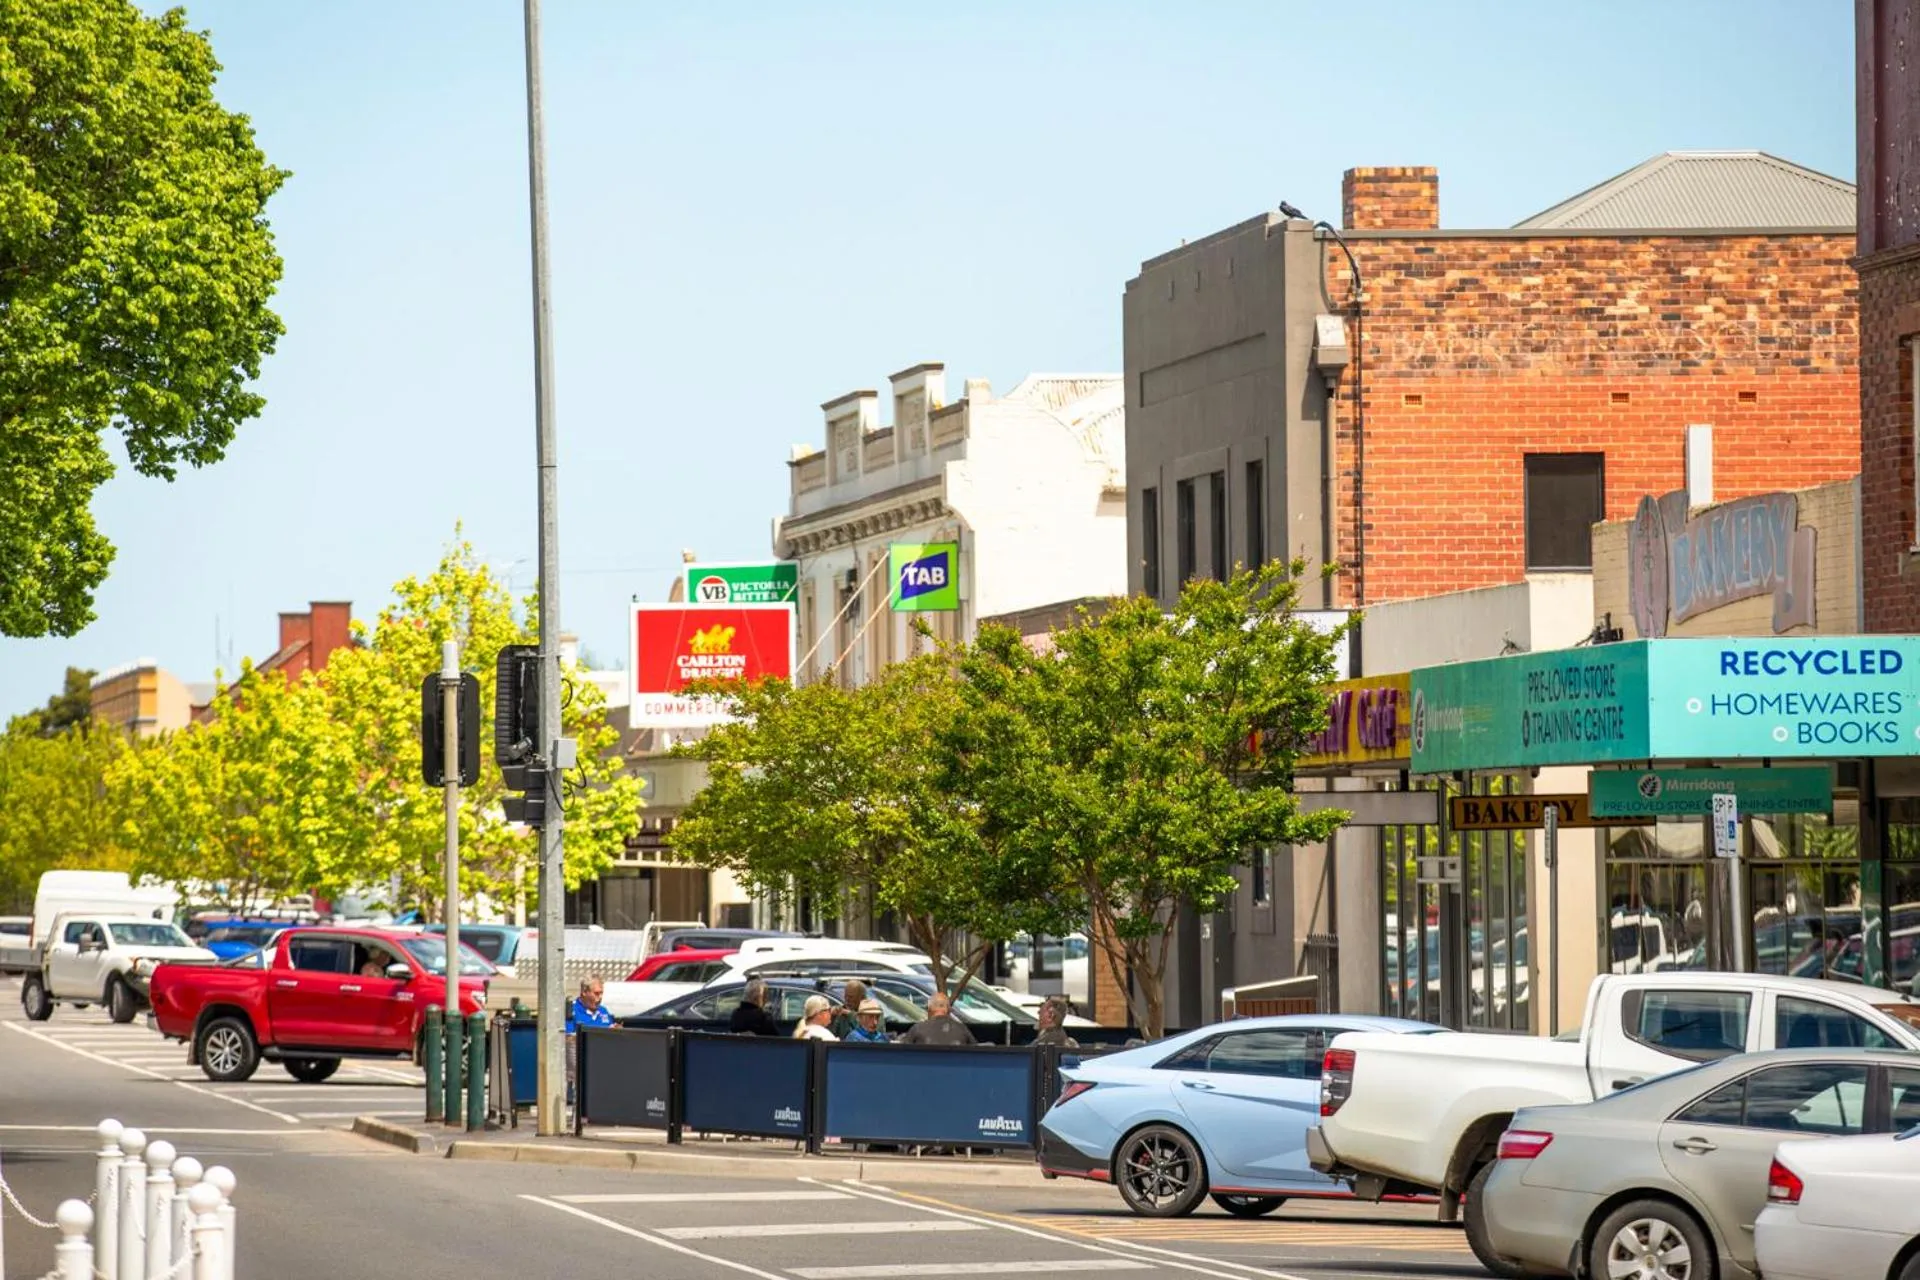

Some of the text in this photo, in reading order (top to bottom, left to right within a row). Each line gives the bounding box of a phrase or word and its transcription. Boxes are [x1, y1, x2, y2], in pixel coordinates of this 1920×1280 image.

[1671, 504, 1795, 616] BAKERY
[731, 581, 790, 592] VICTORIA
[905, 566, 946, 587] TAB
[701, 586, 727, 600] VB
[676, 655, 747, 667] CARLTON
[1720, 649, 1904, 677] RECYCLED
[1528, 663, 1616, 705] PRE-LOVED STORE
[1711, 691, 1902, 715] HOMEWARES
[1532, 708, 1582, 745] TRAINING
[1584, 705, 1625, 741] CENTRE
[1797, 720, 1900, 745] BOOKS
[1666, 778, 1735, 793] Mirridong
[1603, 799, 1664, 812] PRE-LOVED
[1666, 799, 1701, 811] STORE
[978, 1116, 1023, 1131] LAVAZZA
